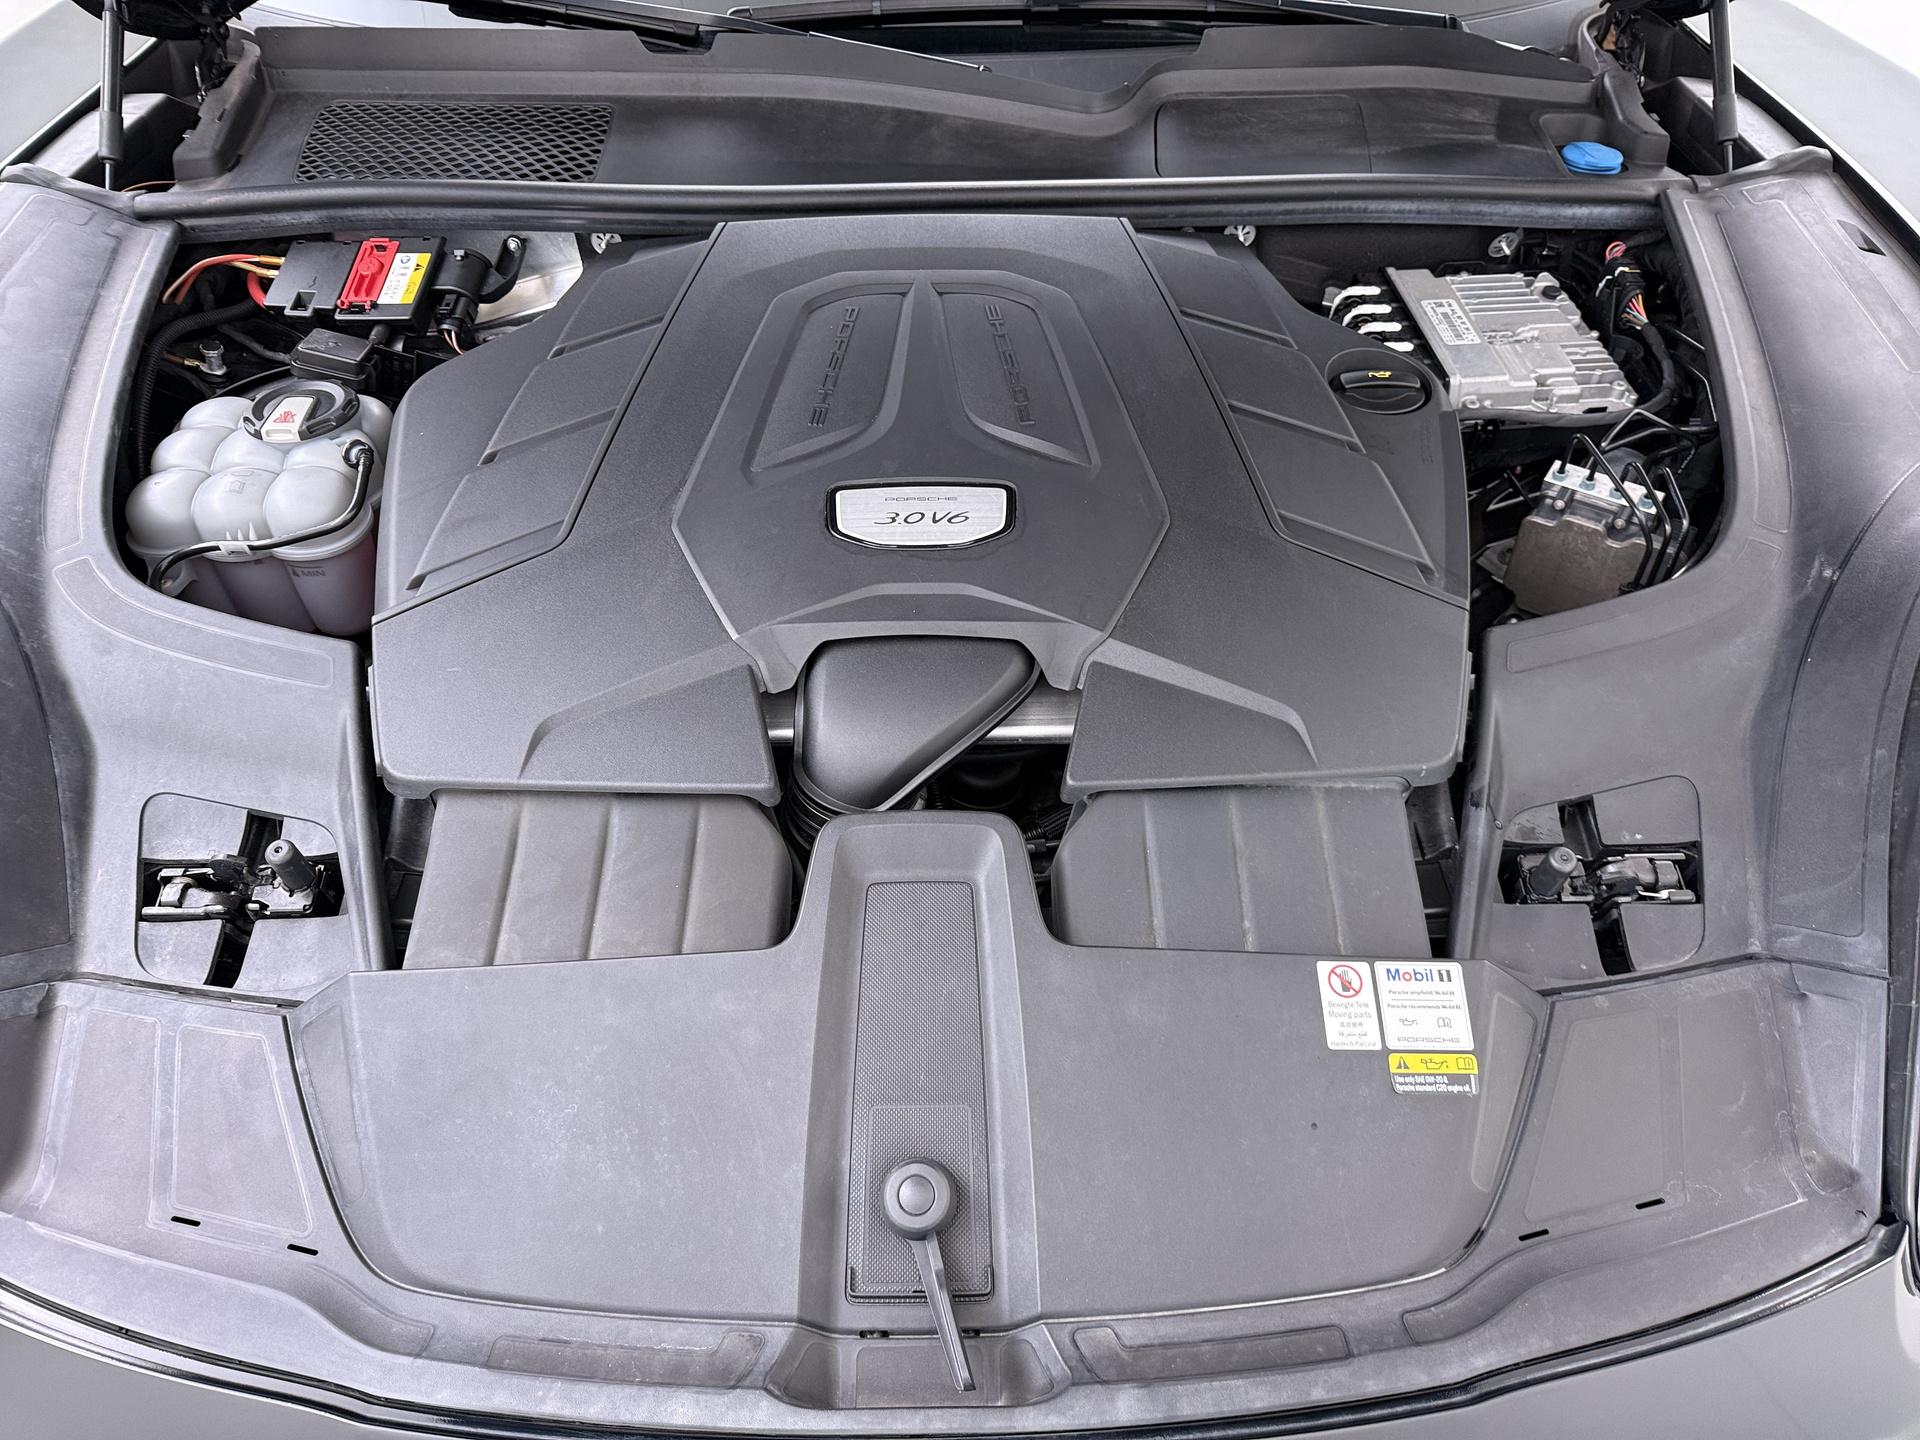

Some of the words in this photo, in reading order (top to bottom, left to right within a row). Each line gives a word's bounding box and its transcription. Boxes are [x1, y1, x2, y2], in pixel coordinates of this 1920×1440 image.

[808, 305, 860, 427] PORSCHE
[984, 303, 1036, 425] PORSCHE
[873, 511, 925, 525] 3.0
[931, 511, 970, 525] V6
[300, 569, 327, 577] MIN
[1386, 967, 1434, 982] Mobil
[1328, 1001, 1354, 1009] Bewegte
[1328, 1010, 1353, 1019] Moving
[1353, 1011, 1372, 1019] parts
[1394, 1075, 1404, 1083] Use
[1404, 1075, 1415, 1084] only
[1415, 1075, 1425, 1083] SAE
